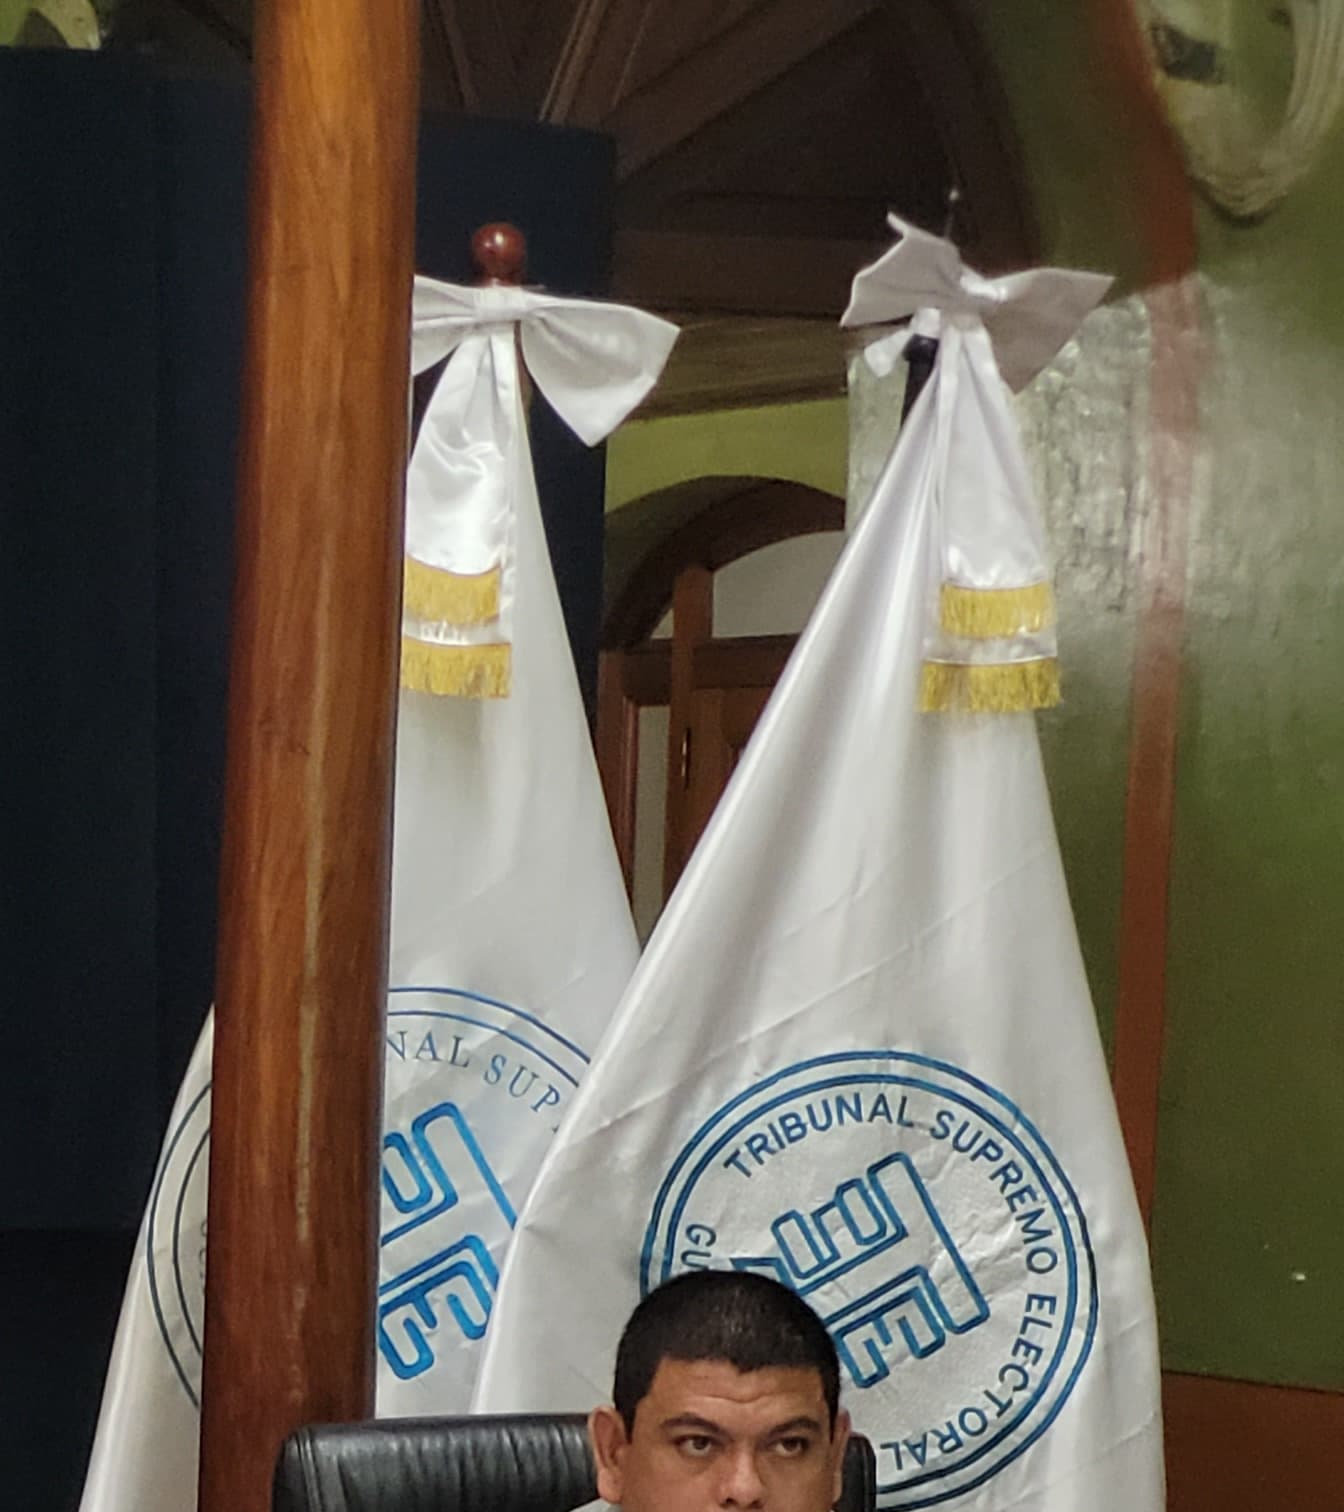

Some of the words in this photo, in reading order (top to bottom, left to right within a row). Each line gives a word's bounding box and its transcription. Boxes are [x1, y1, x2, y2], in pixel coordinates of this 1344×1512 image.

[723, 1092, 914, 1178] TRIBUNAL
[930, 1110, 1058, 1274] SUPREMO
[880, 1293, 1057, 1471] ELECTORAL
